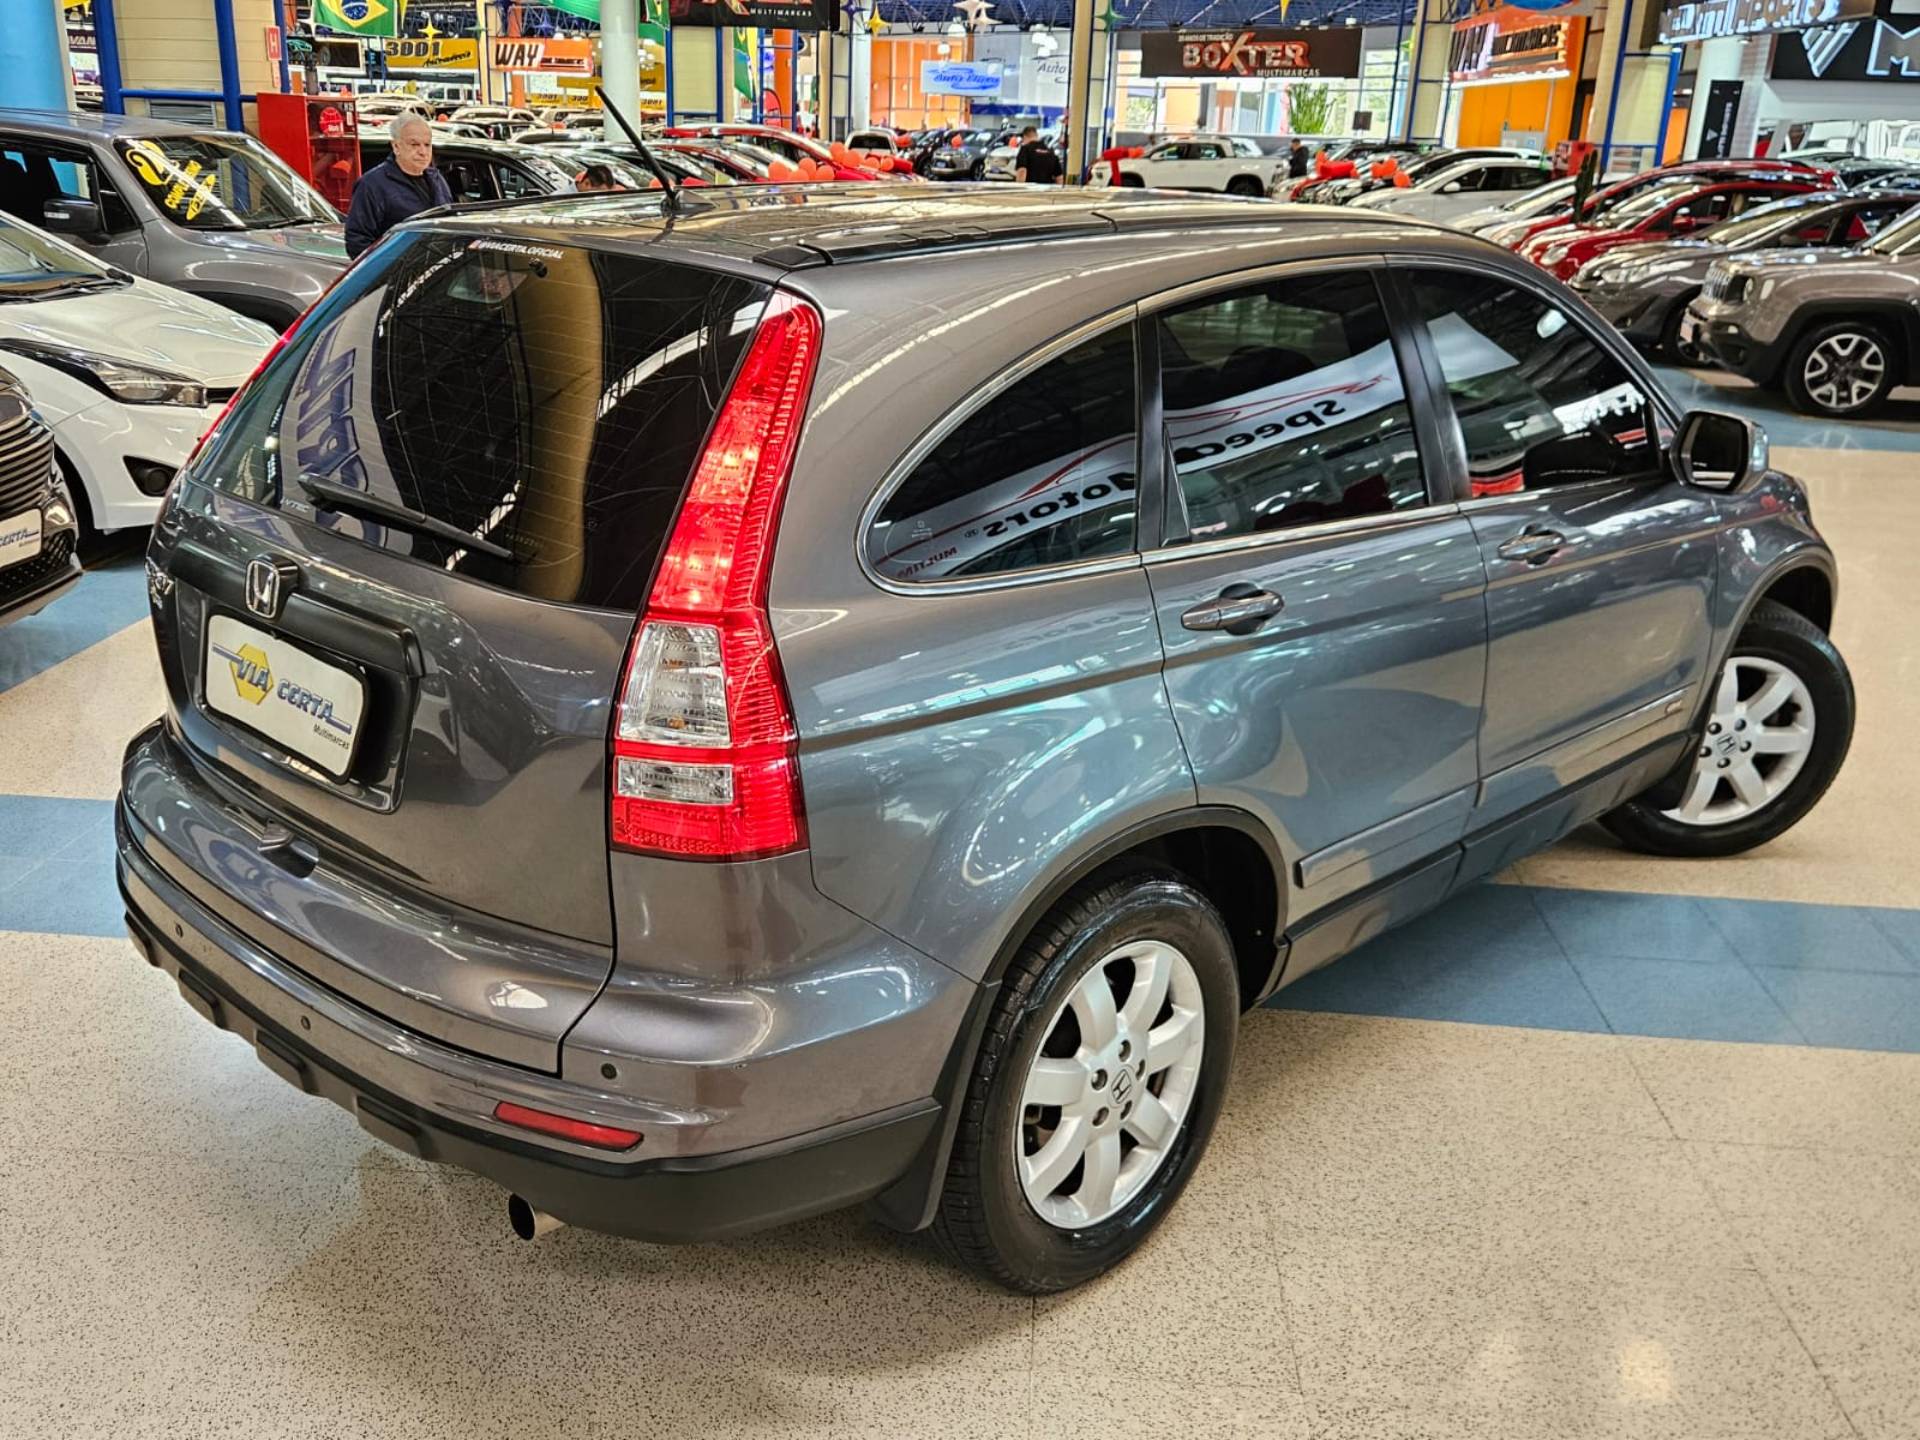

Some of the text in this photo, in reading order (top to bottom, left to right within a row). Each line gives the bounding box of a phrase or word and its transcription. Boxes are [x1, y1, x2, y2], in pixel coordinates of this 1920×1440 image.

[750, 8, 812, 17] MULTIMARCAS
[386, 41, 441, 57] 3001
[495, 43, 539, 66] WAY
[1182, 32, 1312, 76] BOXTER
[1256, 67, 1320, 78] MULTIMARCAS
[236, 657, 335, 722] VIA CERTA
[314, 722, 351, 751] Multimarcas
